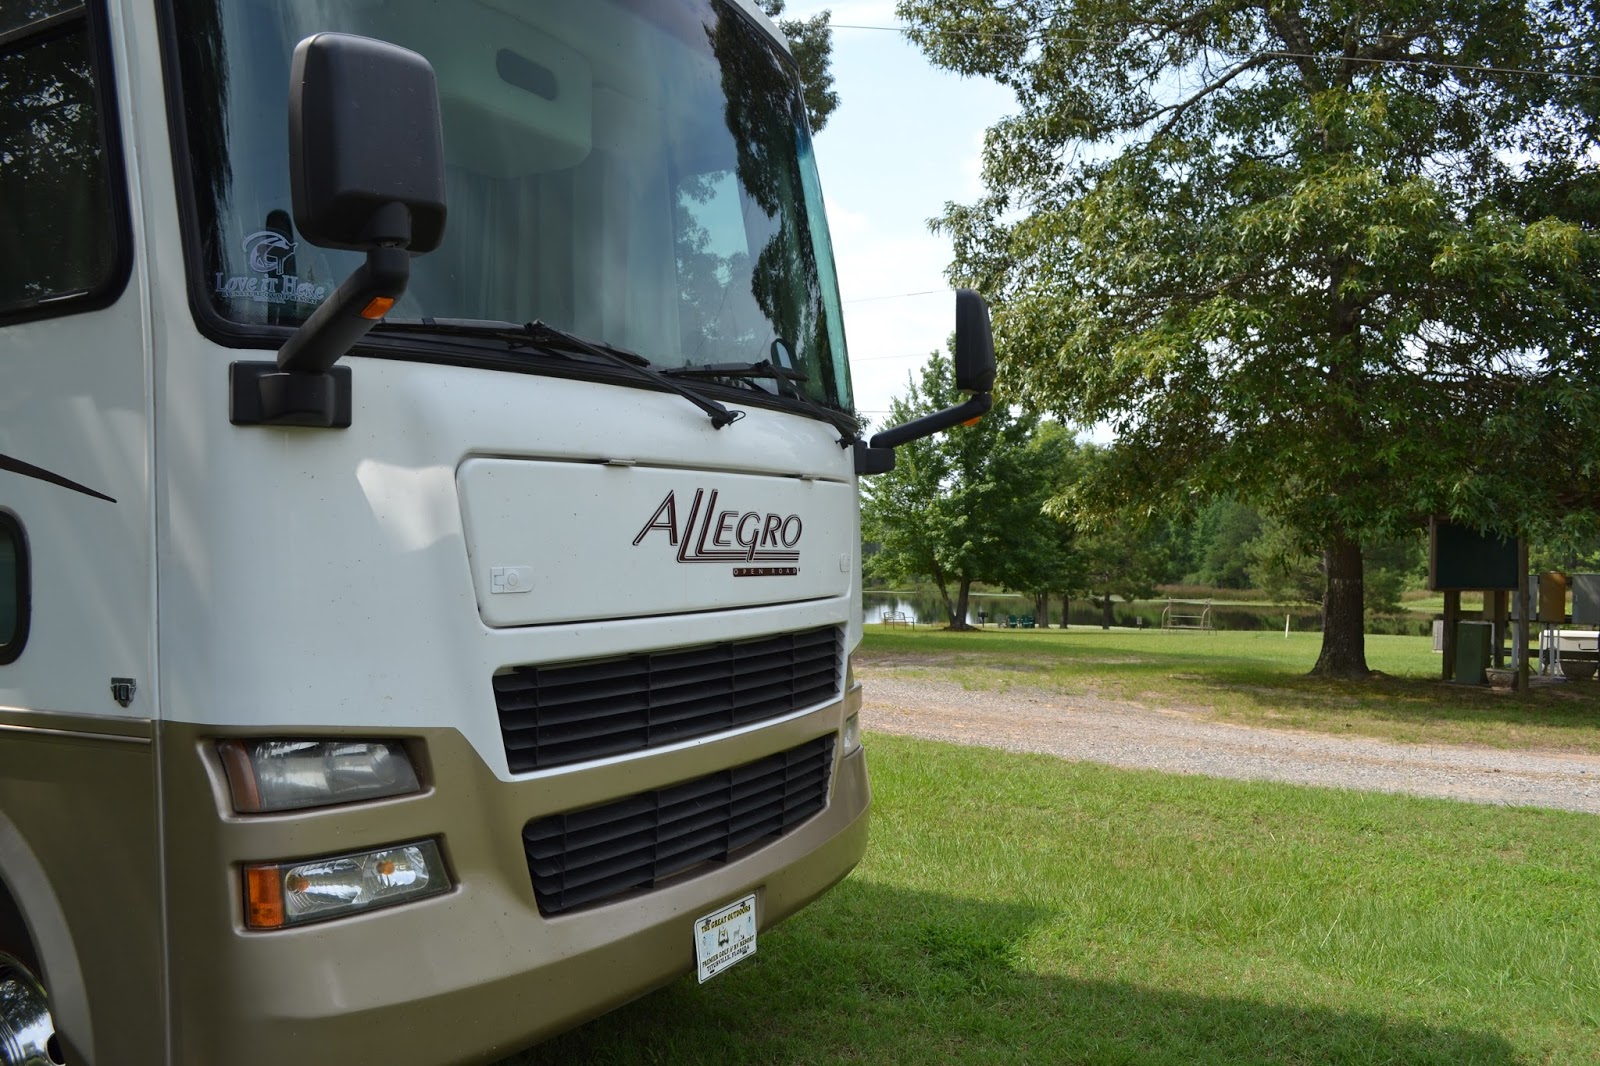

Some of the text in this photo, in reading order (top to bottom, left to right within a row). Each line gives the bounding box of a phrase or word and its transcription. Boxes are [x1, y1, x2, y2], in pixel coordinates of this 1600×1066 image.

[632, 488, 802, 563] ALLEGRO
[733, 567, 797, 576] OPEN ROAD
[711, 915, 727, 929] GREAT
[727, 904, 751, 921] OUTDOORS
